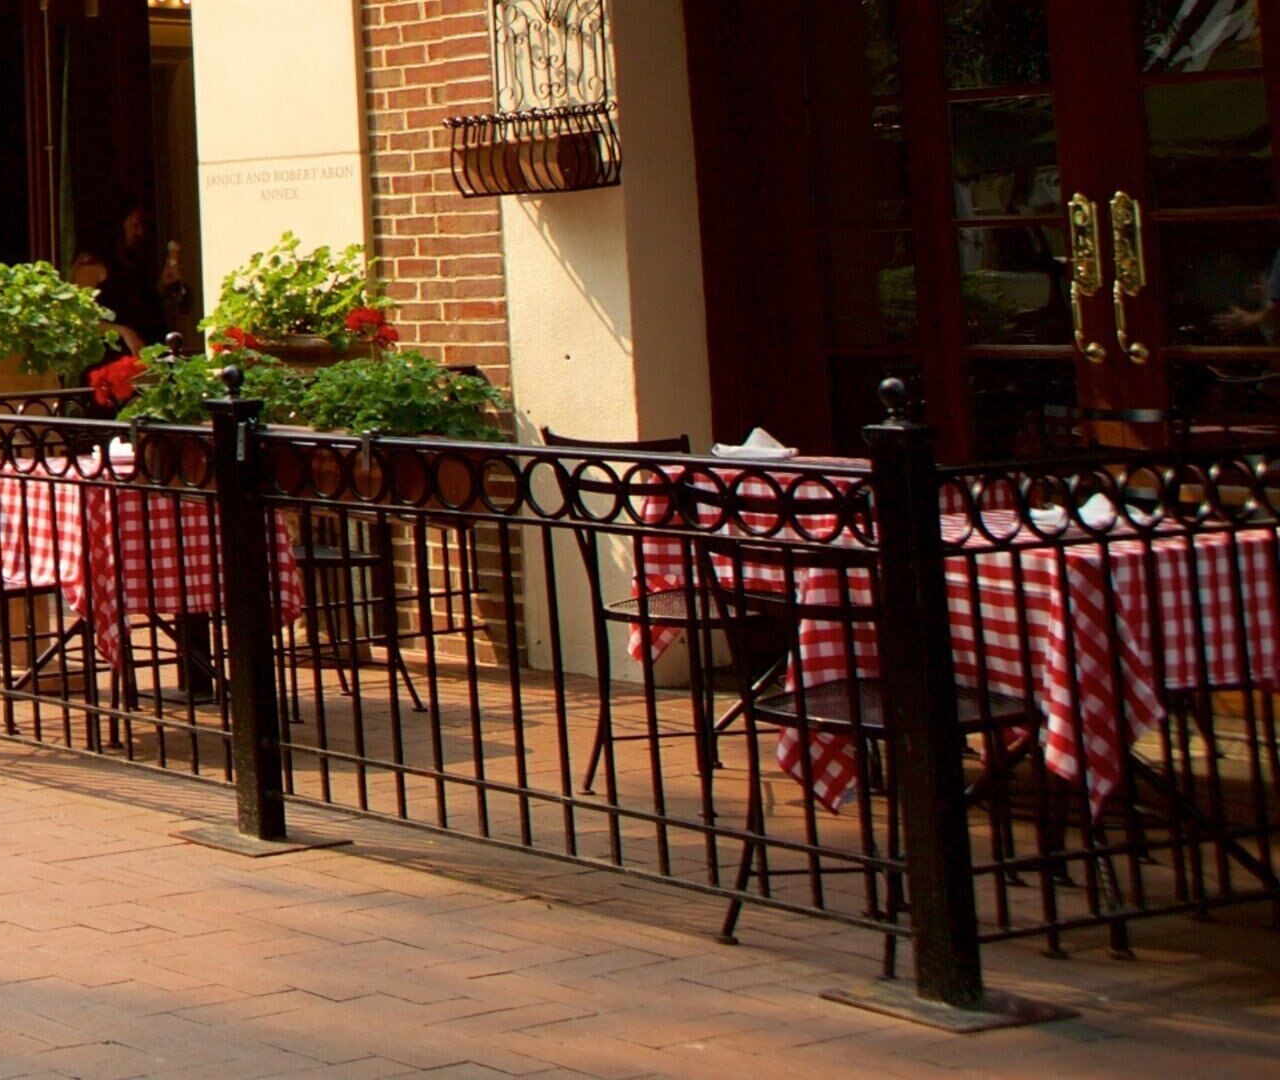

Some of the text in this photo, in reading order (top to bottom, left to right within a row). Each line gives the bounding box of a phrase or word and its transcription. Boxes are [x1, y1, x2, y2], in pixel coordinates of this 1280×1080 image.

[205, 164, 353, 188] JANICE AND ROBERT ARON
[259, 188, 299, 202] ANNEX
